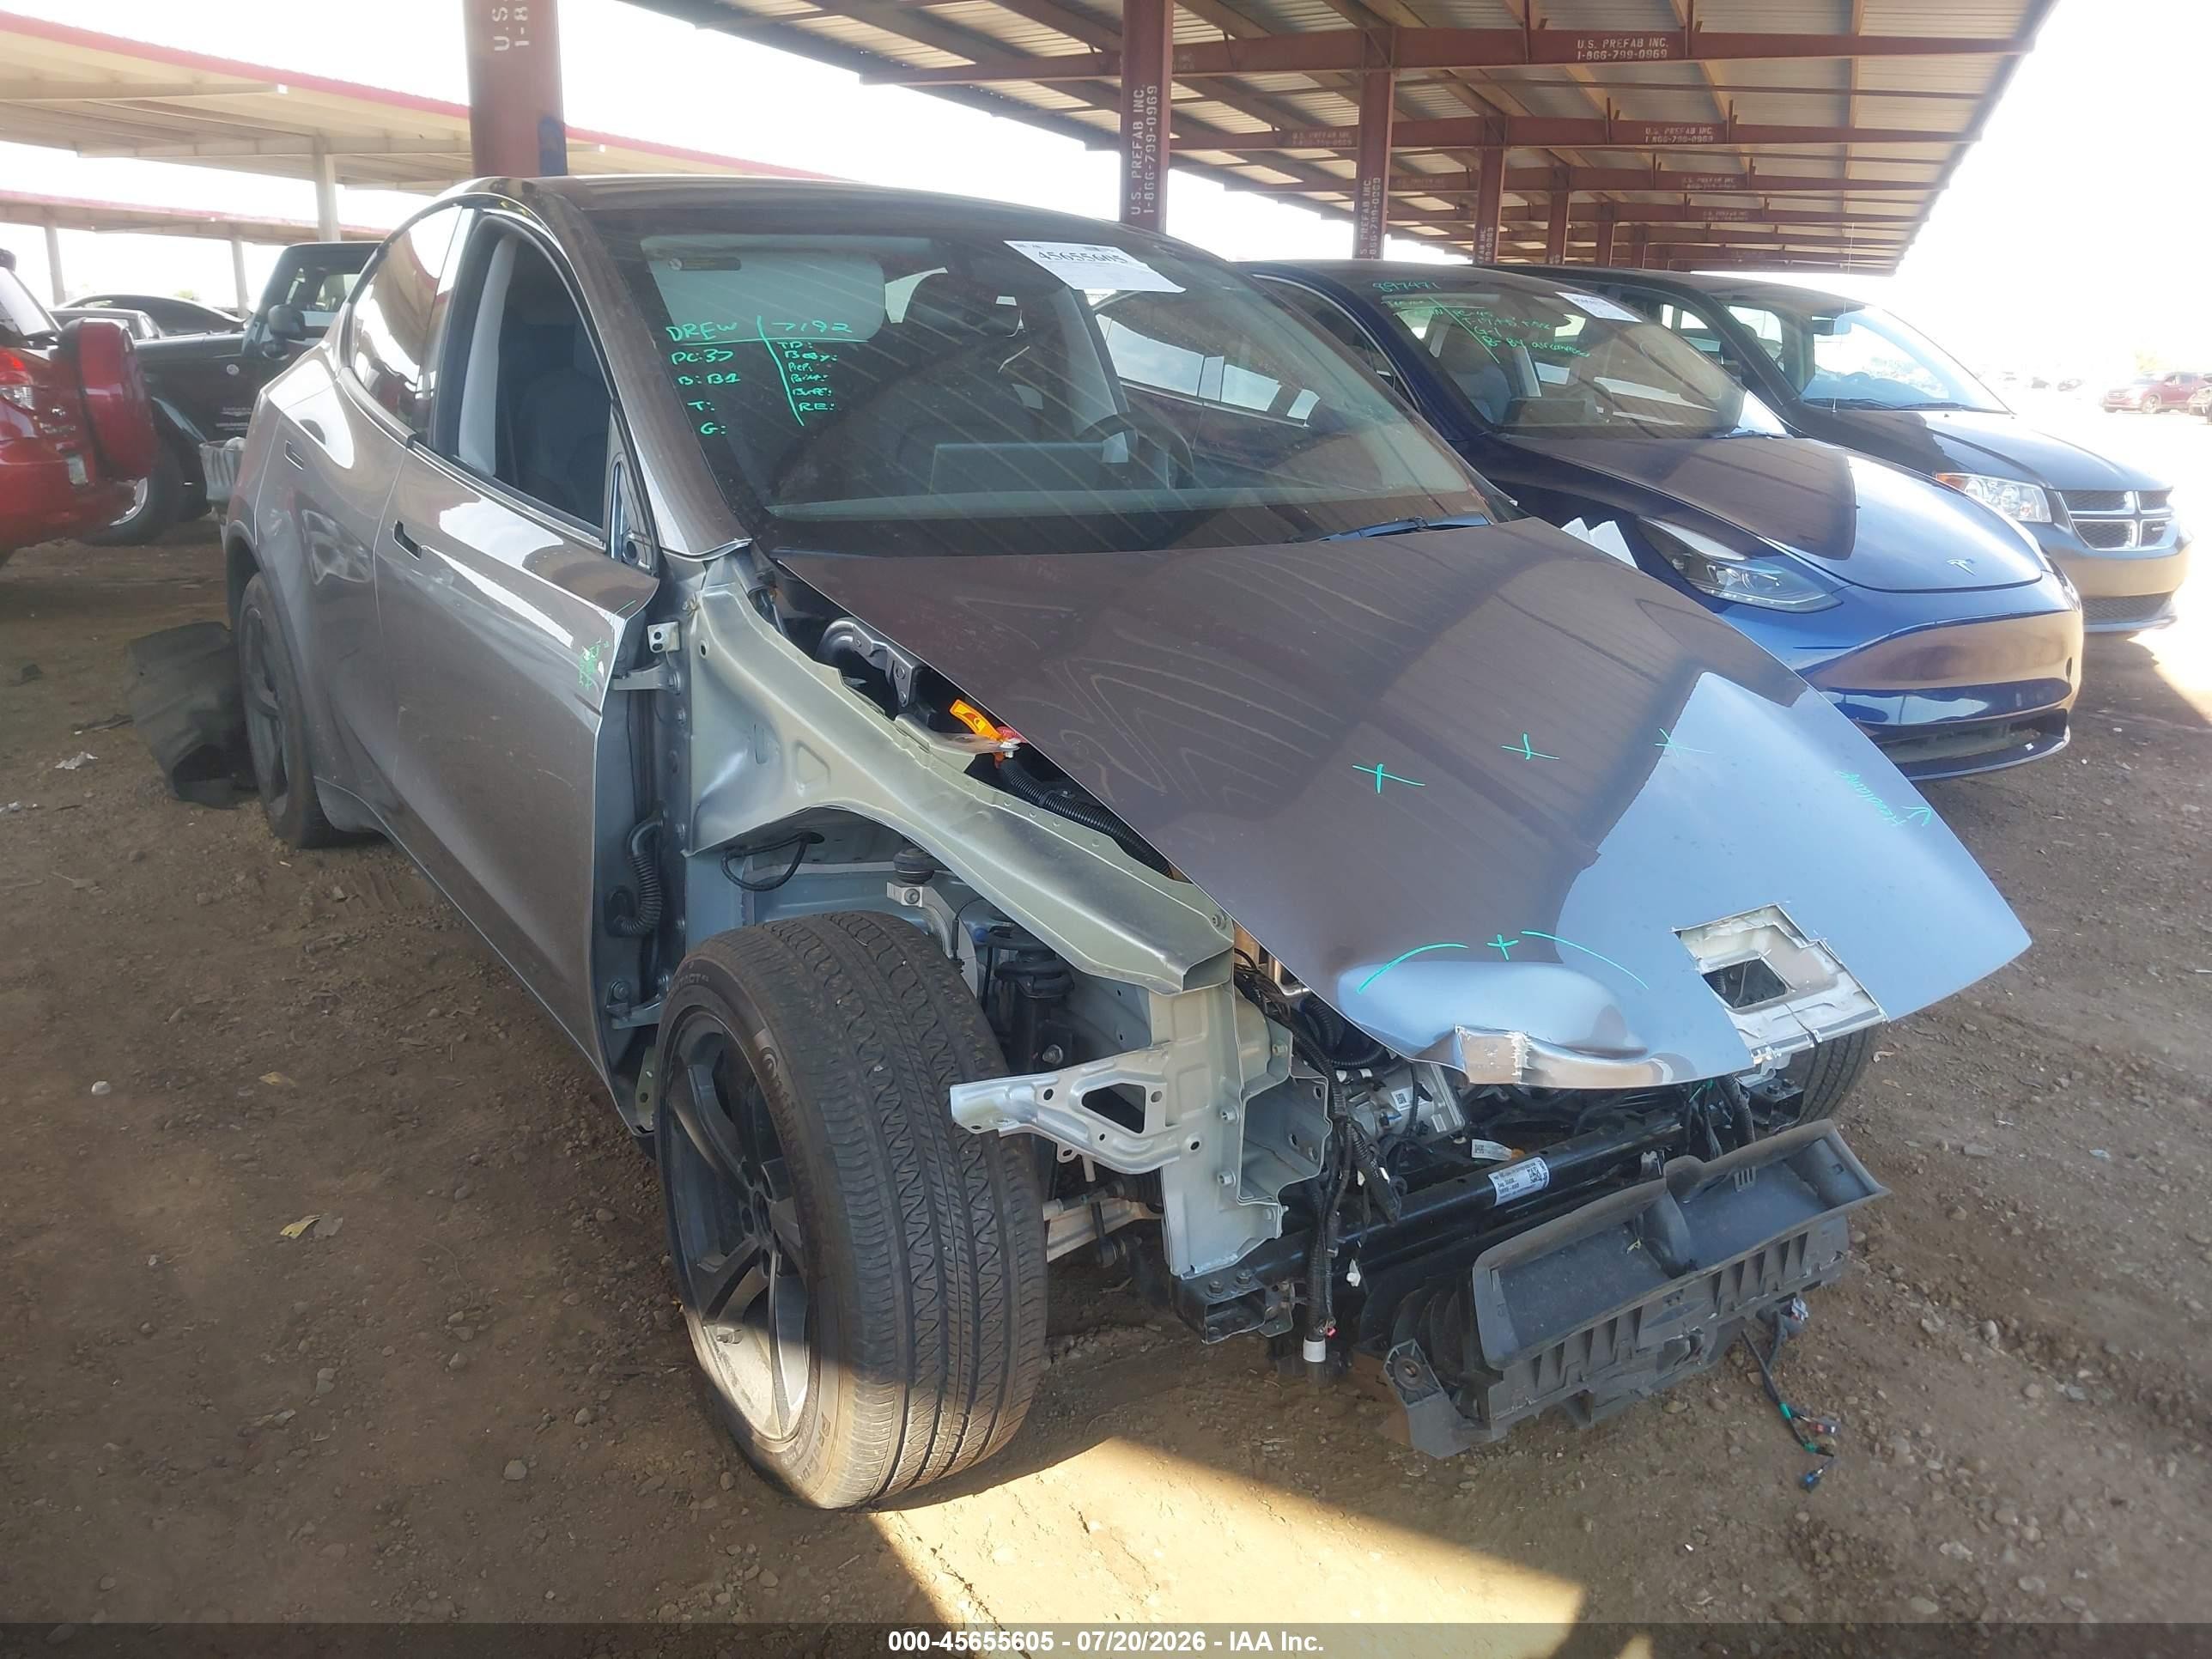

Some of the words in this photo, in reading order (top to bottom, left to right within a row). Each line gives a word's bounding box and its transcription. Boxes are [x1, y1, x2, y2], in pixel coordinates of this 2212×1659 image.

[1577, 40, 1597, 49] U.S.
[1602, 38, 1644, 48] PREFAB
[1649, 38, 1669, 47] INC.
[1577, 49, 1668, 60] 1-866-799-0969
[1133, 84, 1145, 113] INC.
[1132, 121, 1144, 179] PREFAB
[1144, 85, 1158, 214] 1-866-799-0969
[1131, 187, 1142, 215] U.S.
[665, 321, 738, 342] DREW
